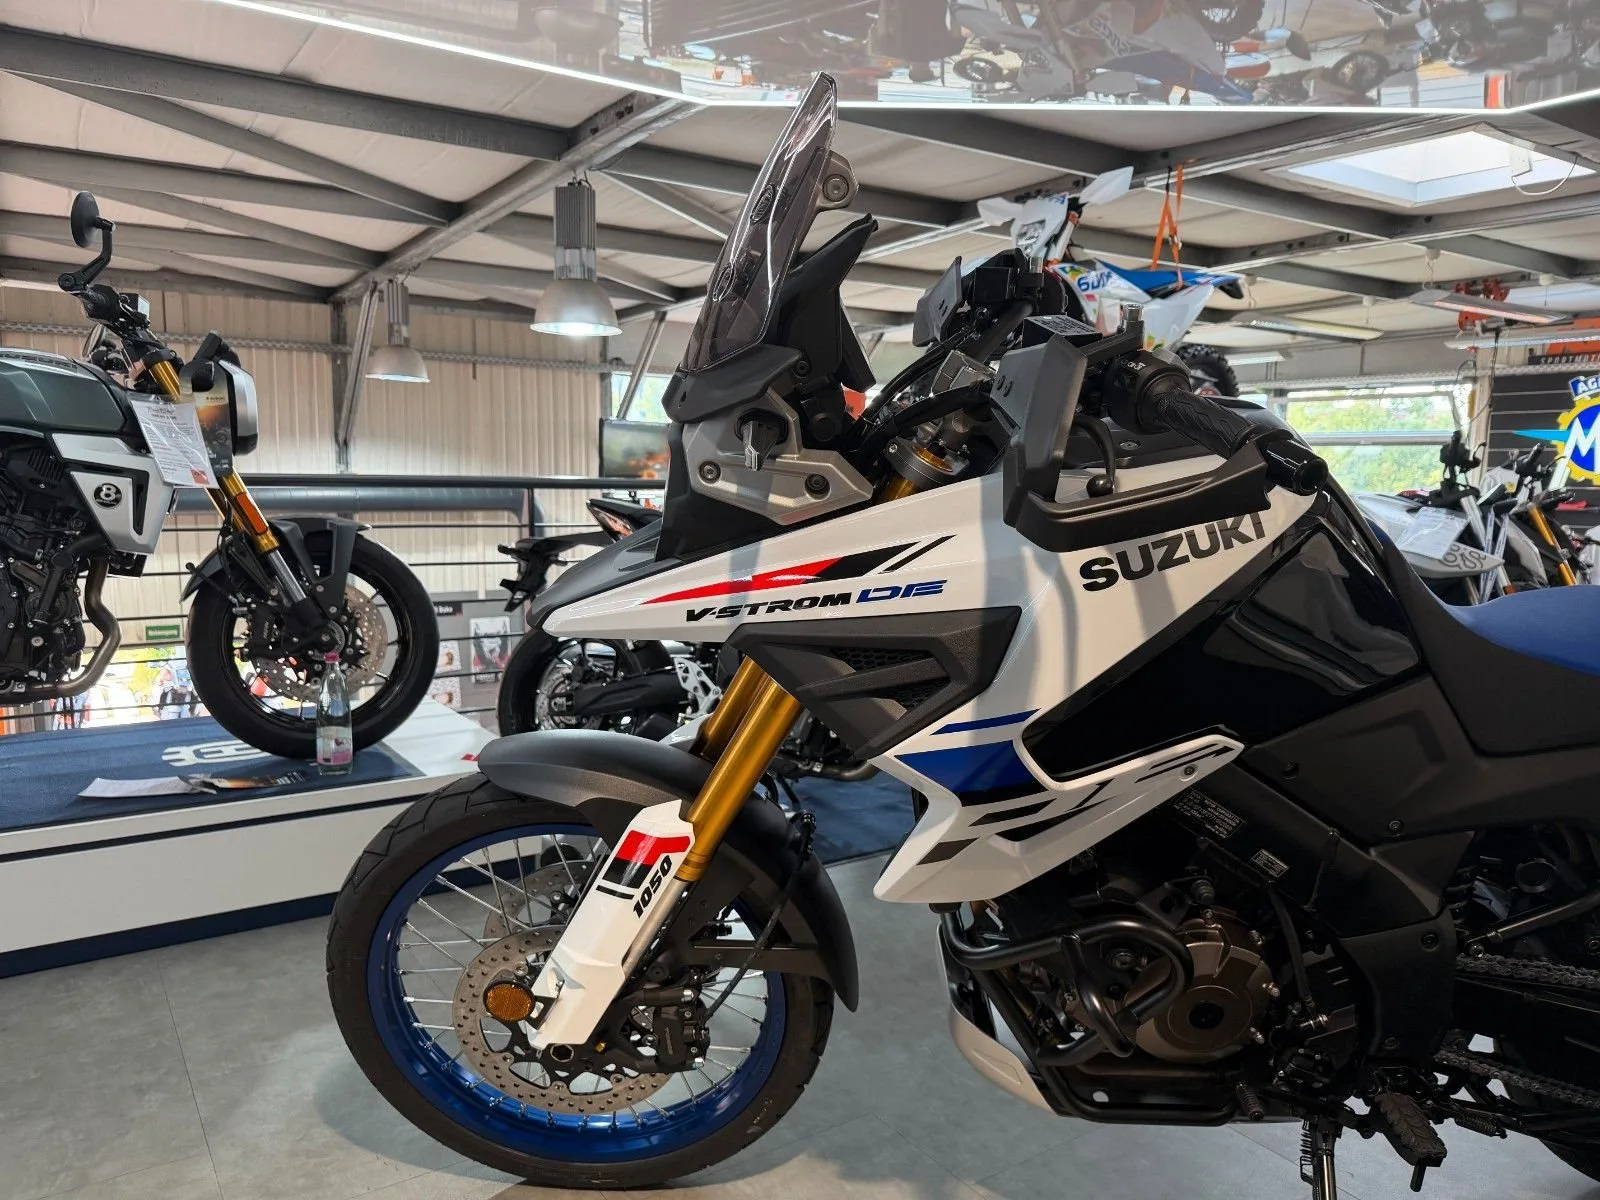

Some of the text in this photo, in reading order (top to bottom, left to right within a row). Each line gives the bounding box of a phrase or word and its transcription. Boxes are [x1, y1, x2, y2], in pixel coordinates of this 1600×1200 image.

[99, 485, 117, 501] 8
[1079, 512, 1266, 592] SUZUKI
[686, 579, 948, 622] V-STROM DE
[633, 854, 672, 918] 1050
